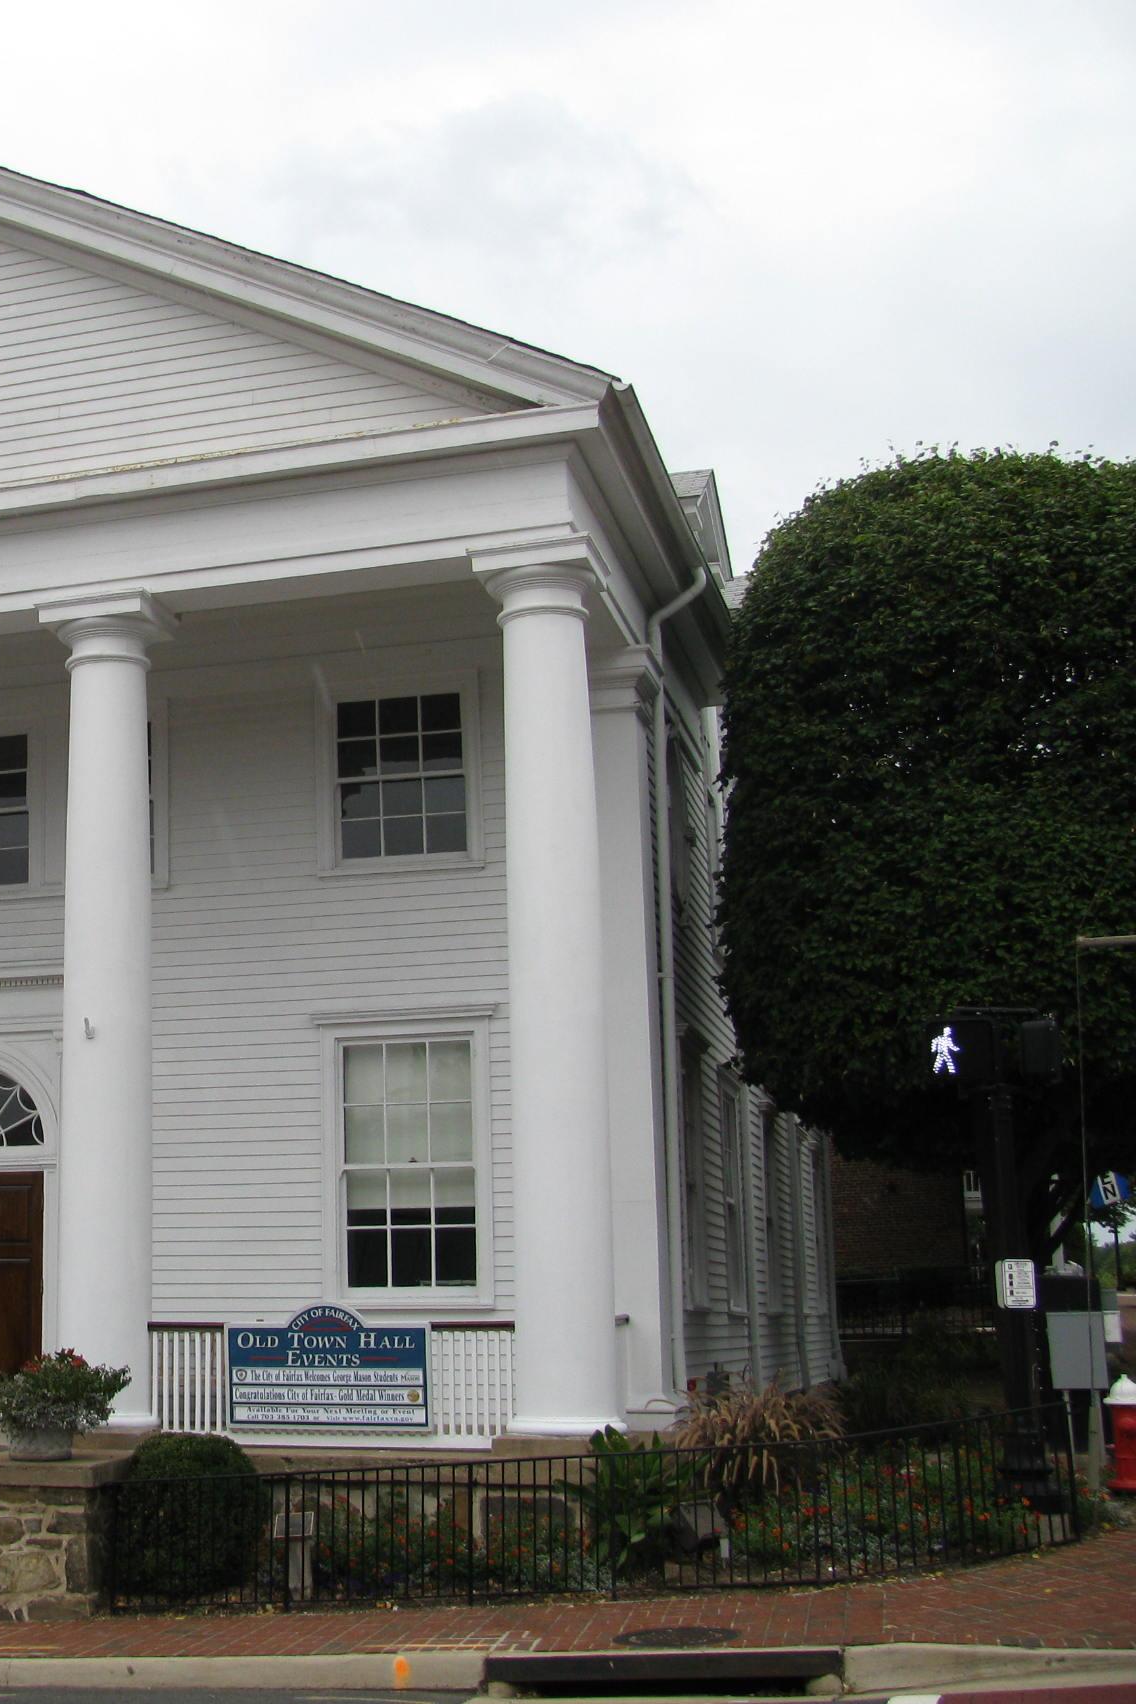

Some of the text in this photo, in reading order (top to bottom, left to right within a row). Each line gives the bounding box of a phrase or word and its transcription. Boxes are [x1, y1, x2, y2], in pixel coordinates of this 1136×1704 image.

[291, 1307, 361, 1331] CITY OF FAIRFAX
[237, 1331, 416, 1349] OLD TOWN HALL
[286, 1349, 361, 1367] EVENTS
[251, 1369, 399, 1383] The City of Fairfax Welcomes George Mason Students
[234, 1387, 285, 1401] Congratulations
[287, 1387, 299, 1402] City
[301, 1388, 308, 1400] of
[338, 1389, 354, 1401] Gold
[356, 1389, 375, 1401] Medal
[377, 1389, 405, 1402] Winners
[345, 1407, 377, 1415] Meeting
